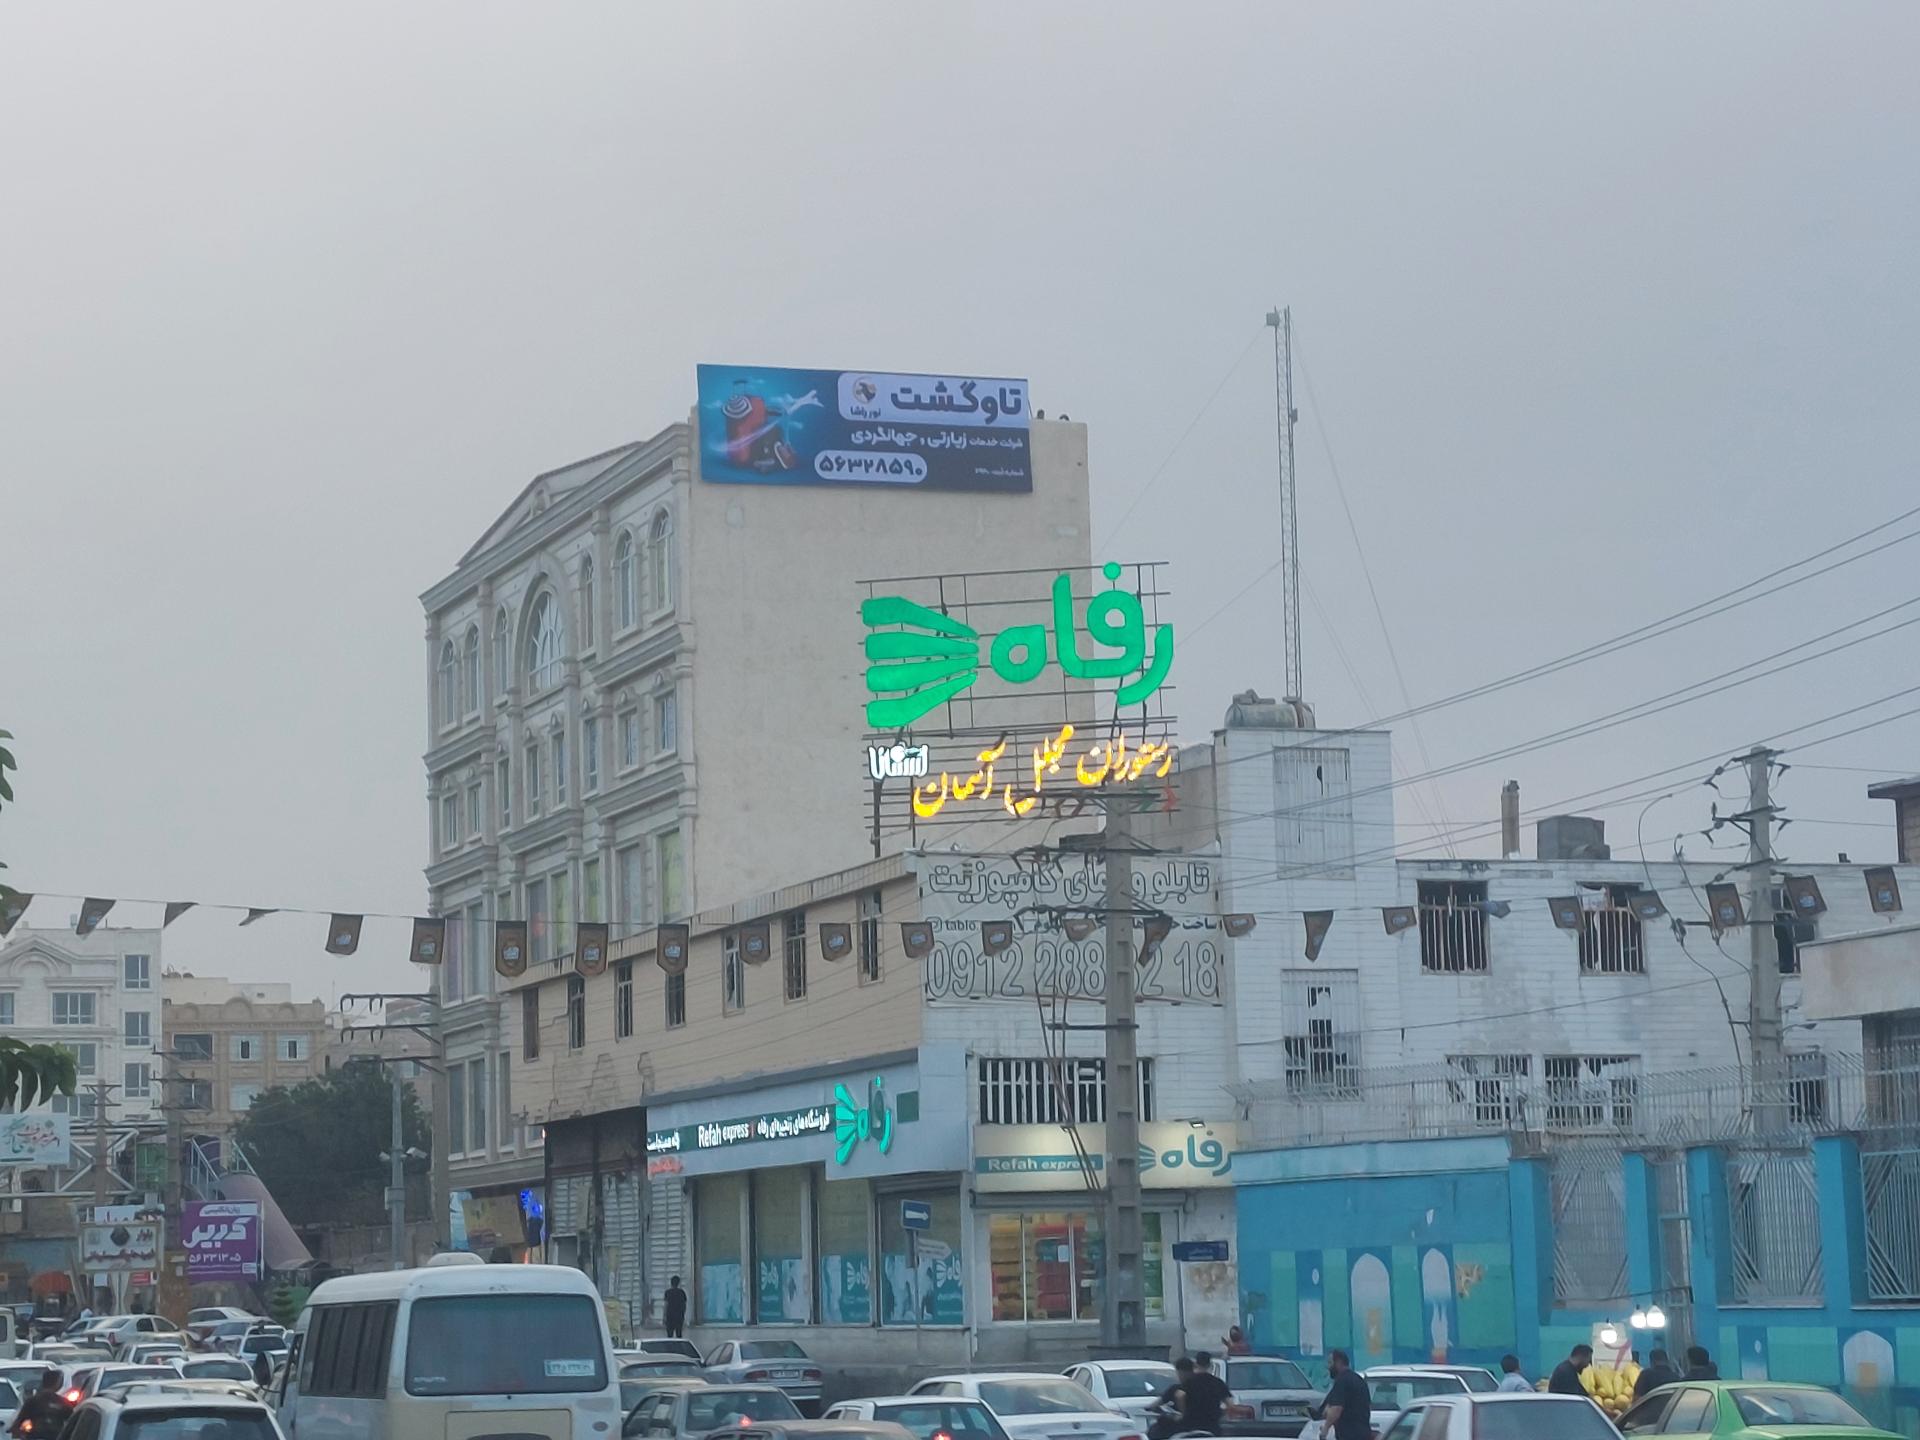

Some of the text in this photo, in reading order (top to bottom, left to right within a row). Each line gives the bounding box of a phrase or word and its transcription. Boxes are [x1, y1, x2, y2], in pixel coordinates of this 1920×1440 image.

[850, 425, 918, 448] جهانگردی
[927, 429, 966, 449] زیارتی
[990, 561, 1174, 707] رفاه
[929, 860, 1058, 910] کامپوزیت
[1152, 861, 1210, 904] تابلو
[926, 941, 1024, 998] 0912
[1174, 941, 1218, 998] 18
[698, 1122, 750, 1148] Refah express
[1161, 1129, 1233, 1177] رفاه
[988, 1158, 1037, 1172] Refah
